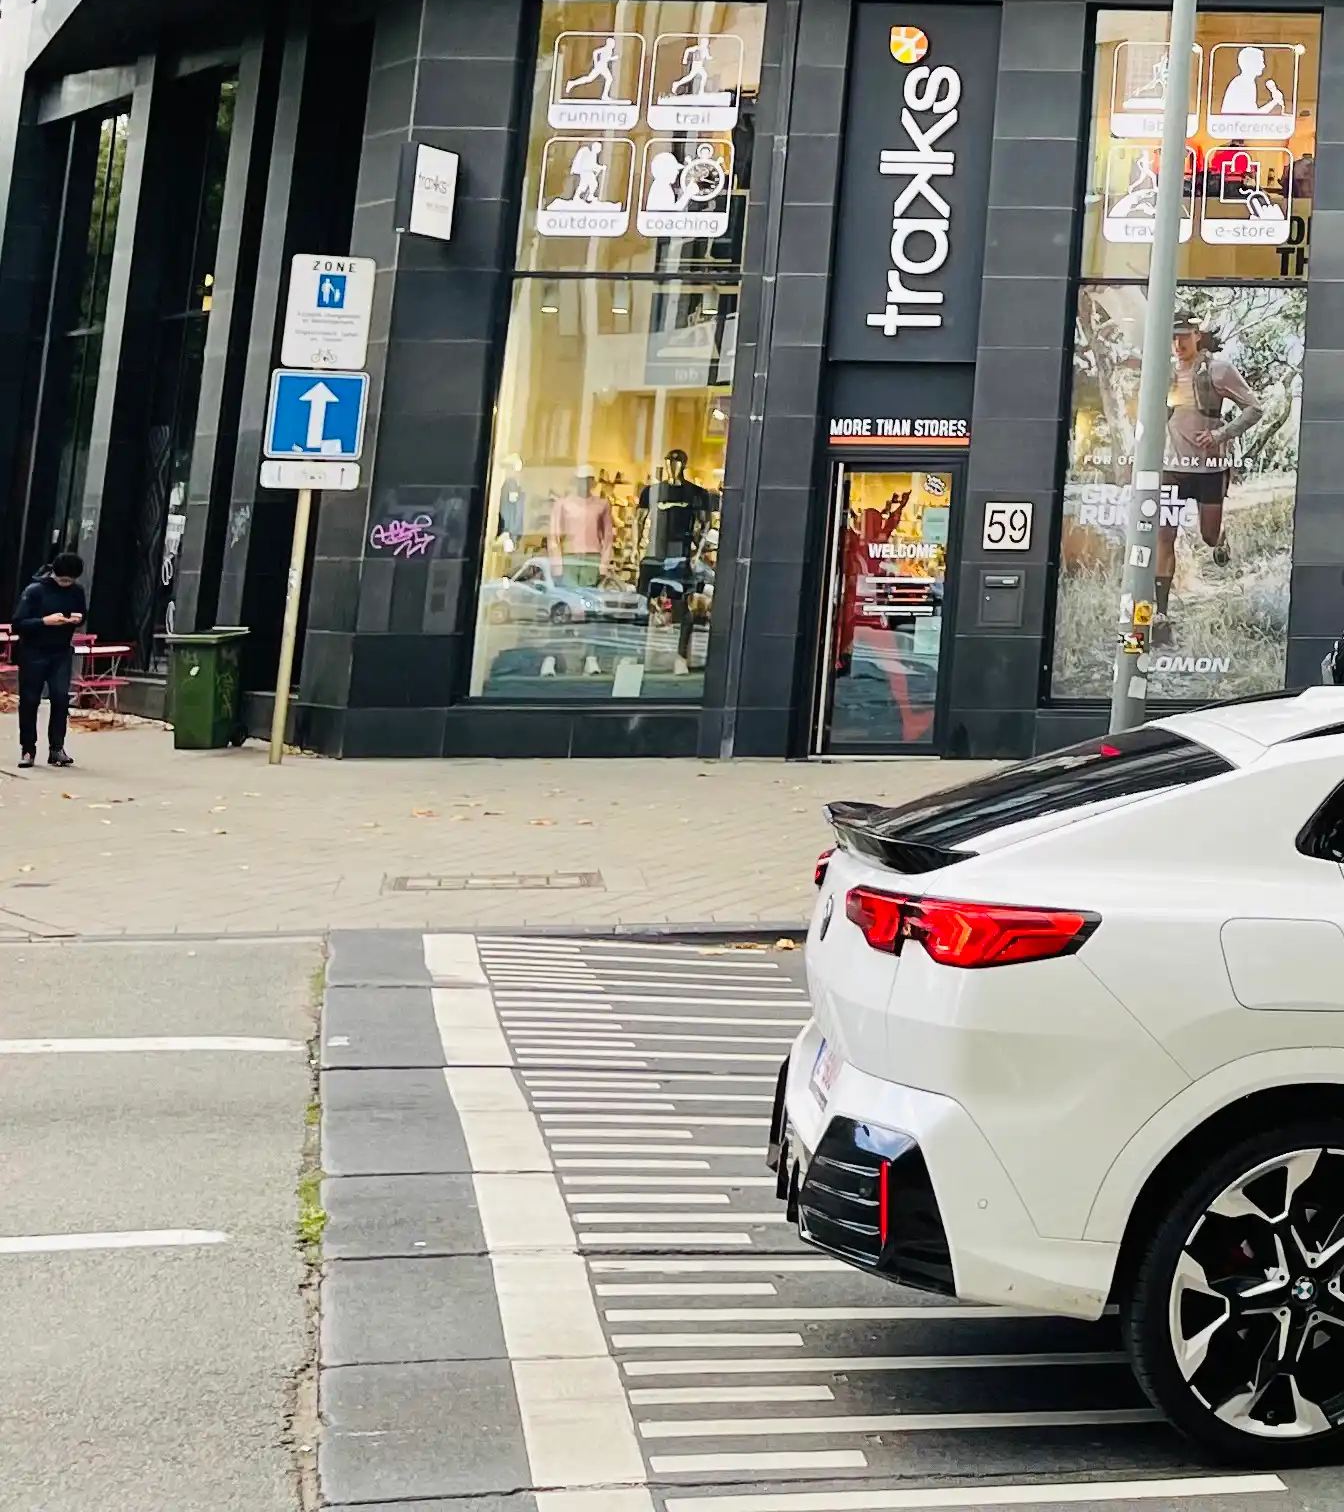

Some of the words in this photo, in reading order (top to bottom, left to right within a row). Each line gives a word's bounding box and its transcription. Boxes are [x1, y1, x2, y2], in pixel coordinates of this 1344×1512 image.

[558, 107, 628, 125] running
[675, 110, 711, 124] trail
[1211, 118, 1291, 134] conferences
[546, 215, 618, 230] outdoor
[645, 216, 719, 234] coaching
[1124, 223, 1155, 236] trav
[1215, 223, 1275, 237] e-store
[312, 260, 357, 273] ZONE
[829, 418, 872, 436] MORE
[876, 418, 912, 436] THAN
[914, 419, 970, 437] STORES.
[1083, 454, 1112, 465] FOR
[1205, 457, 1254, 469] MINDS
[987, 509, 1028, 544] 59
[868, 543, 938, 559] WELCOME
